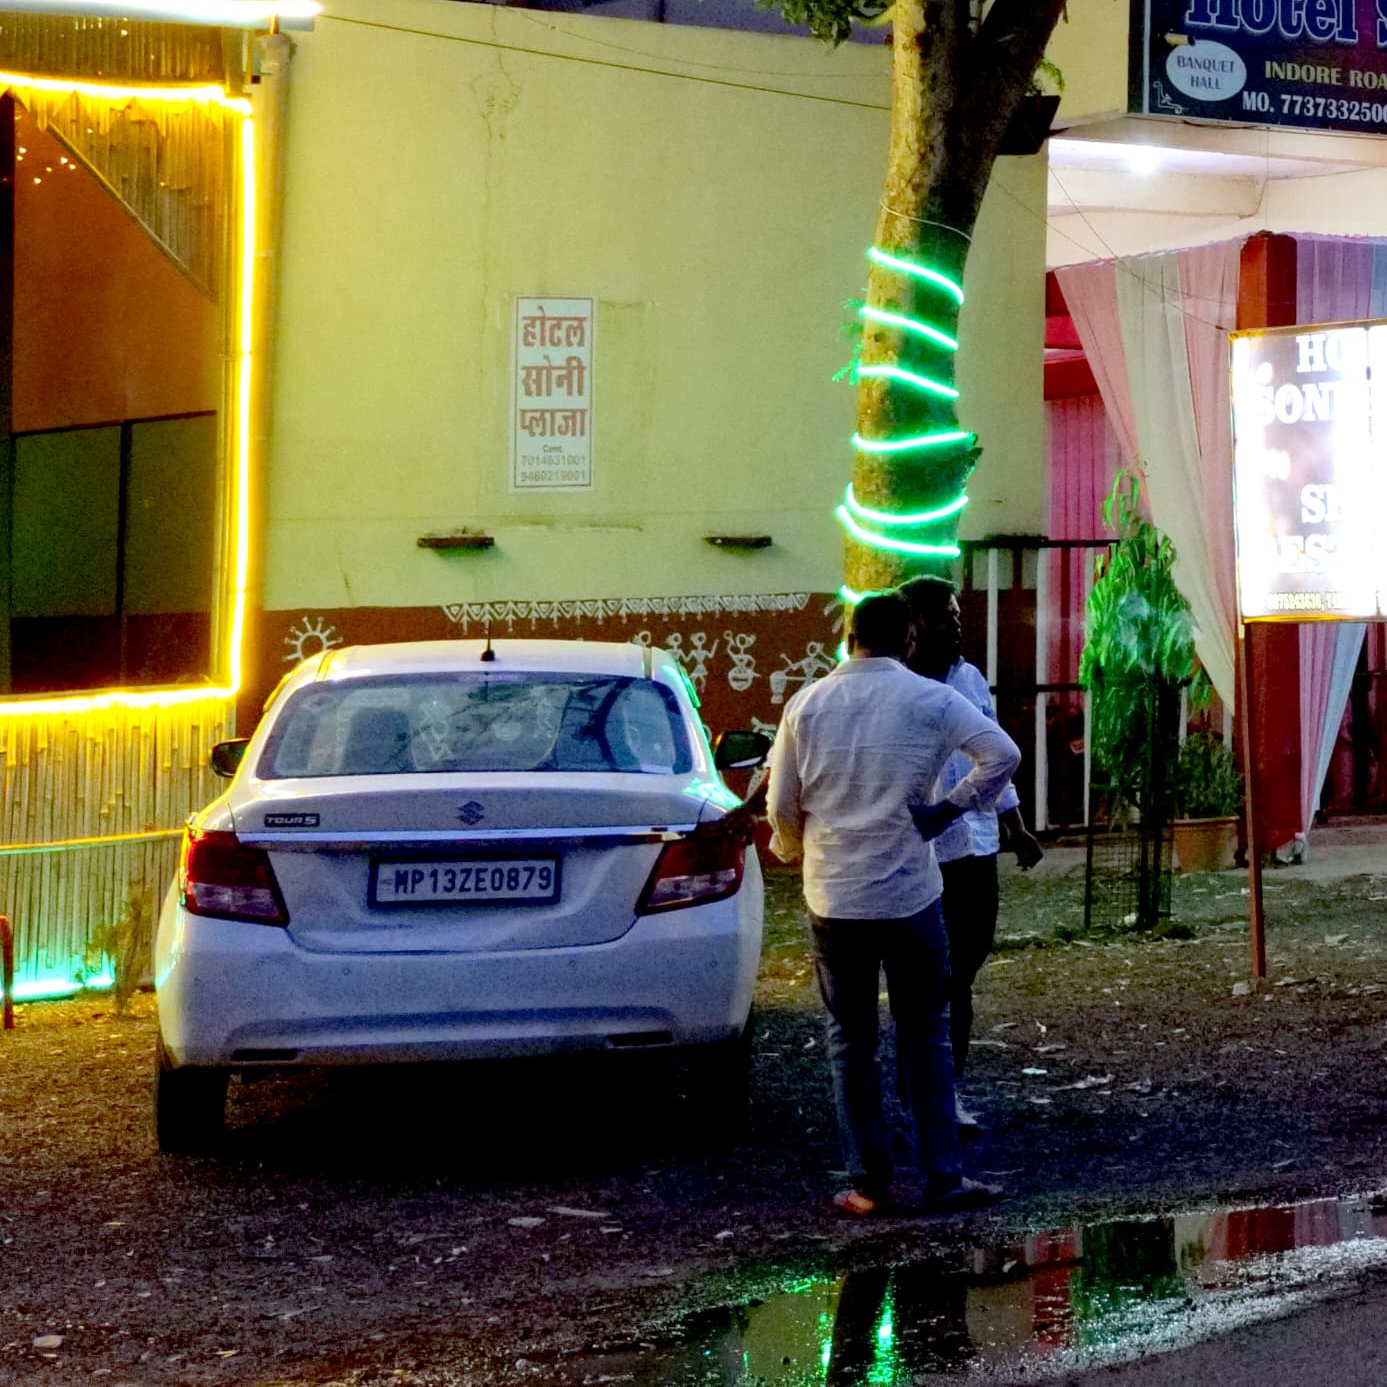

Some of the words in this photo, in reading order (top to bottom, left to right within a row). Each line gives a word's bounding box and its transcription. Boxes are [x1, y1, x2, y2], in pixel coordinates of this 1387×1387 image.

[1177, 55, 1235, 73] BANQUET
[1265, 61, 1342, 85] INDORE
[1190, 75, 1223, 91] HALL
[1243, 91, 1274, 113] MO.
[522, 305, 587, 347] होटल
[521, 355, 586, 397] सोनी
[520, 409, 588, 437] प्लाजा
[394, 866, 553, 895] MP13ZE0879
